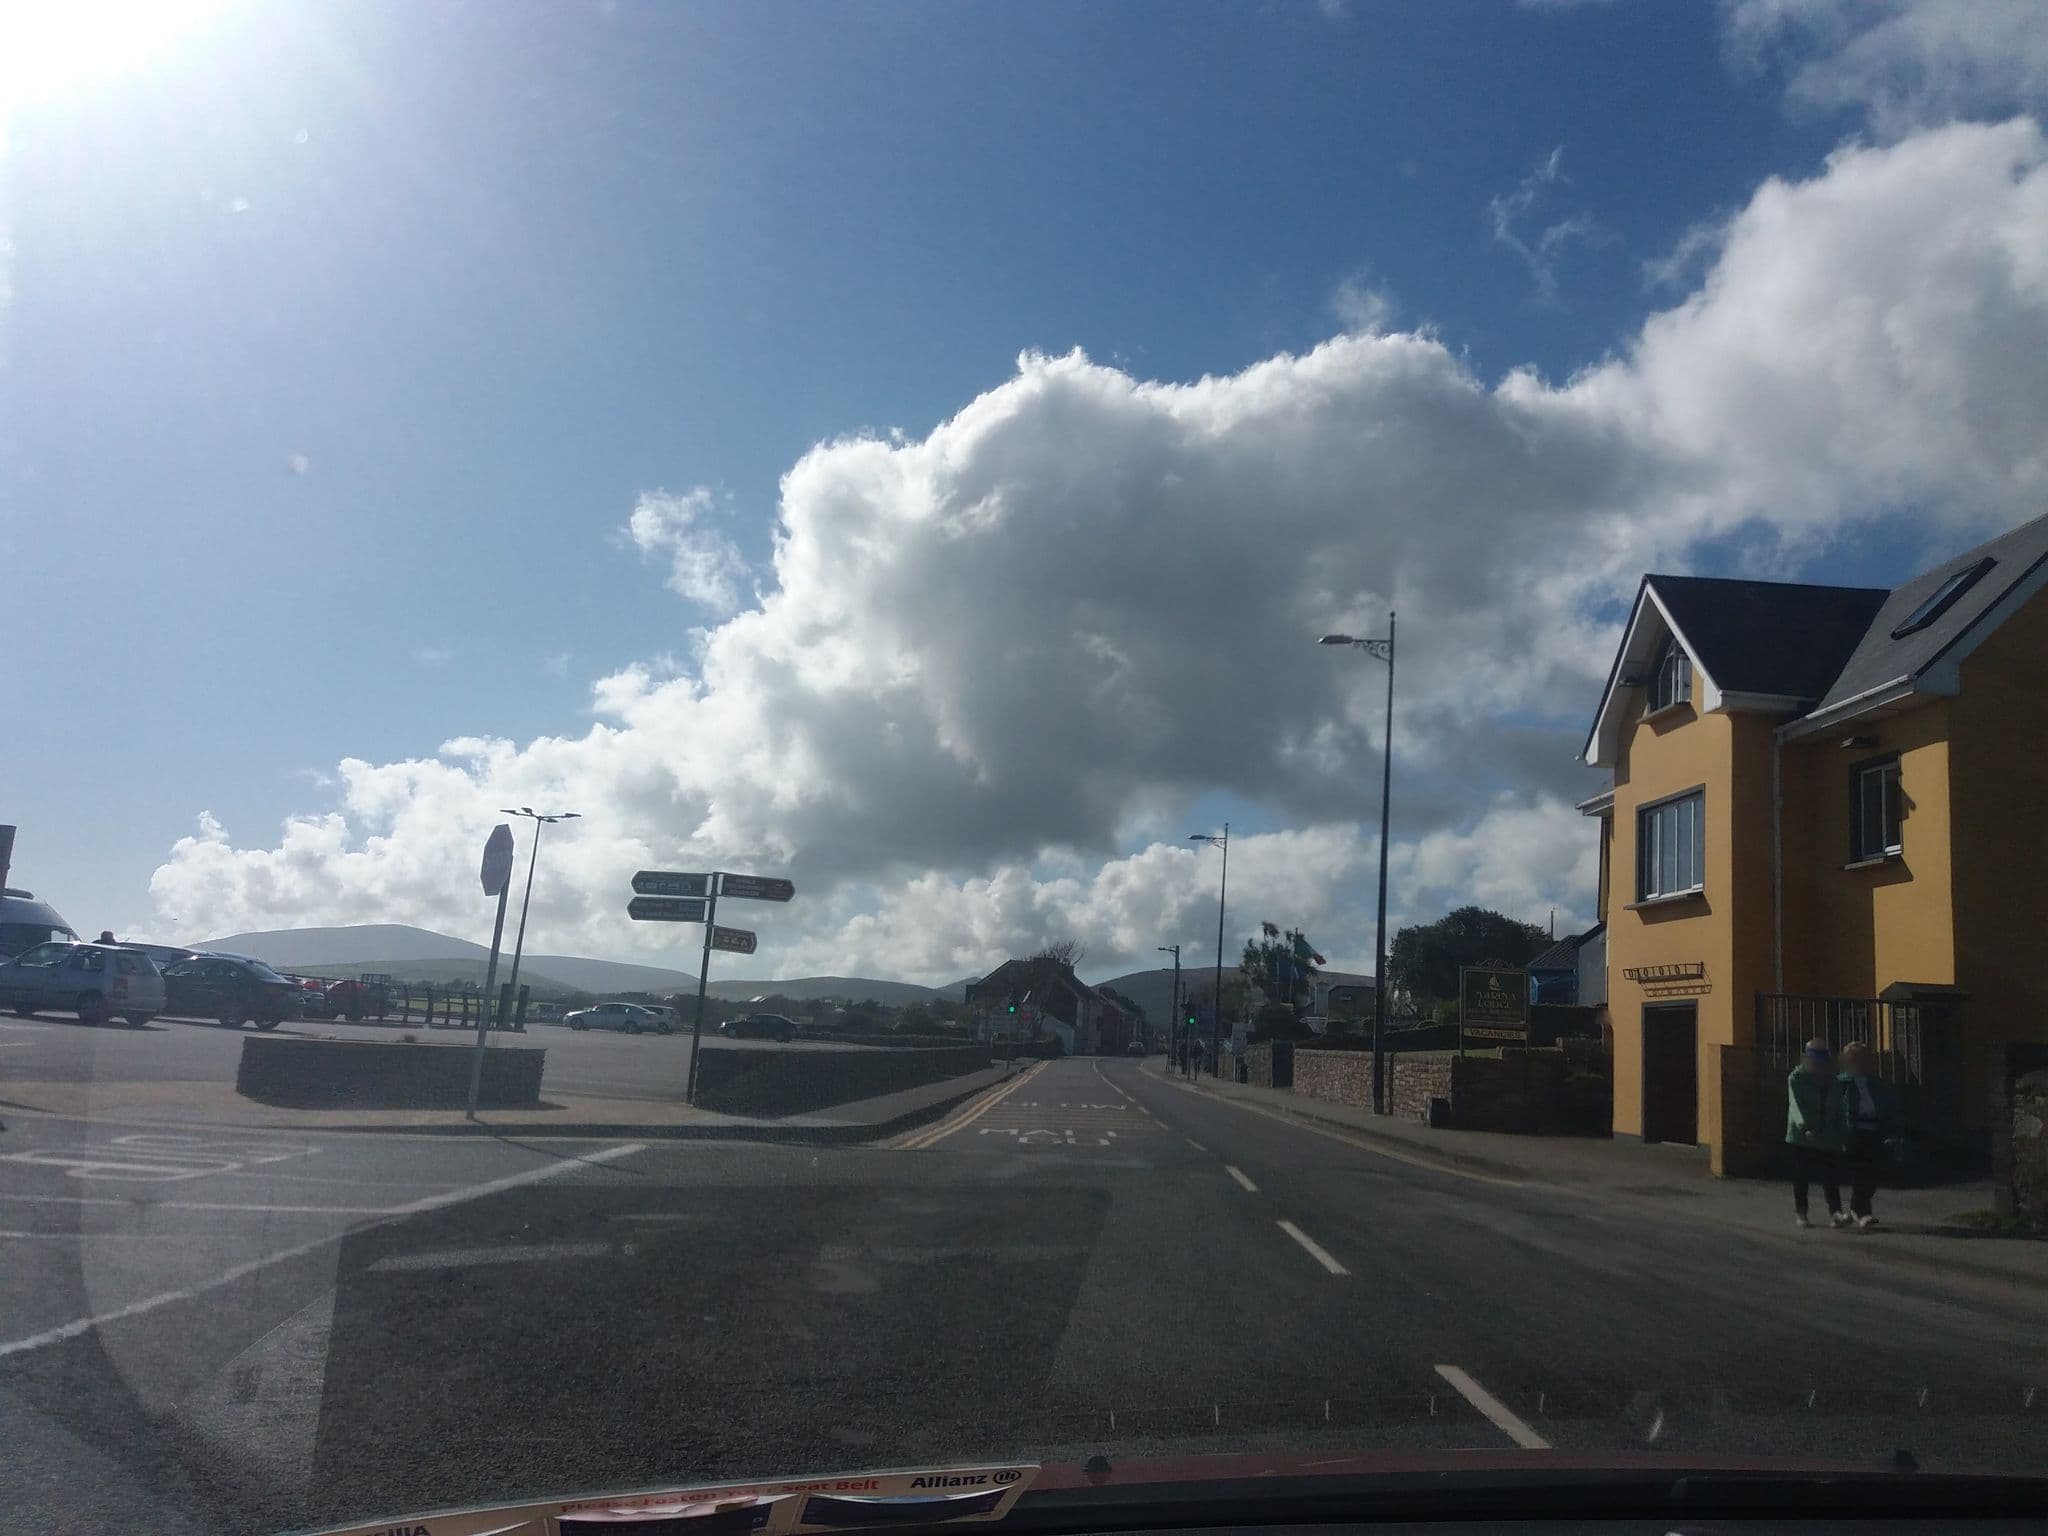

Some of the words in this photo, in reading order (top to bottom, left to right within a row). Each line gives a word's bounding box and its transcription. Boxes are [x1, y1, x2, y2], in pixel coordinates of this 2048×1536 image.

[781, 1481, 830, 1492] Seat
[836, 1478, 880, 1491] Belt
[910, 1474, 989, 1489] Allianz
